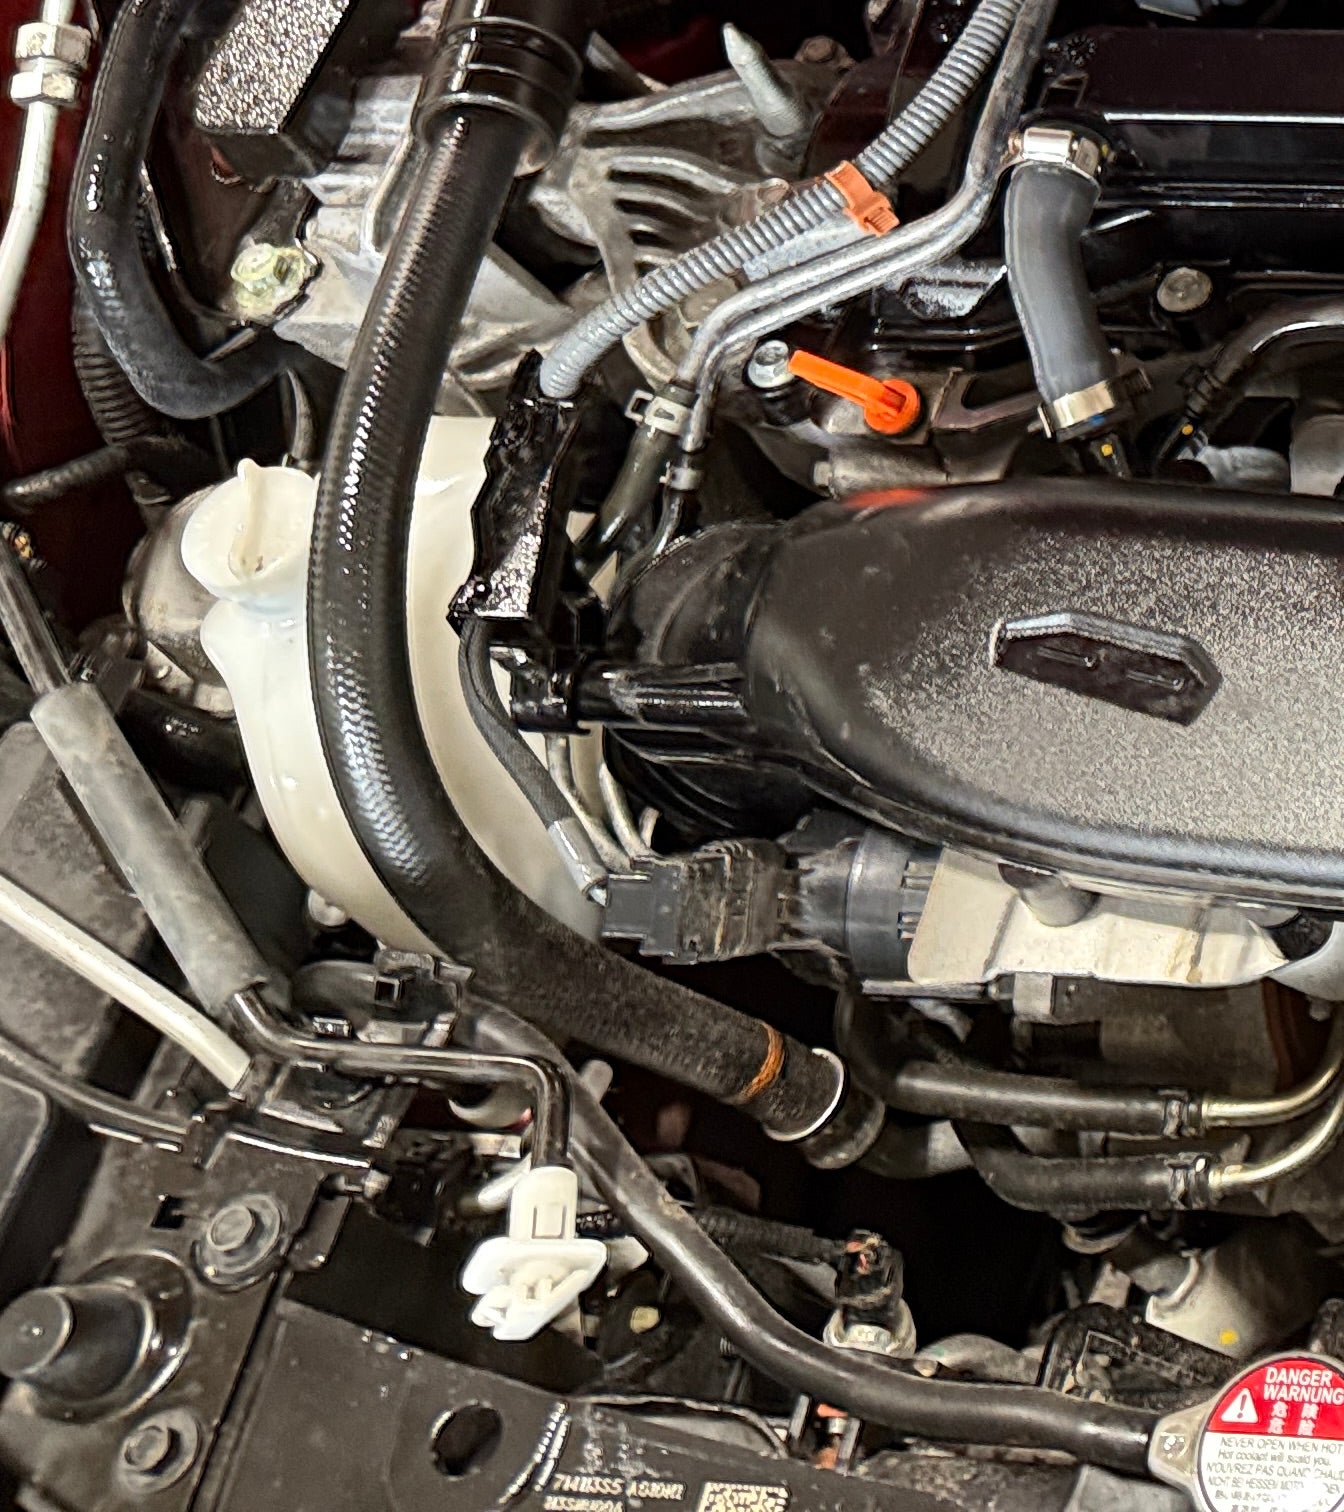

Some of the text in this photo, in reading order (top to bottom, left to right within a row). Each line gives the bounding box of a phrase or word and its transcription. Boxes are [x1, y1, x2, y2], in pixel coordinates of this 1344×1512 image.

[1265, 1366, 1334, 1388] DANGER
[1219, 1437, 1254, 1449] NEVER
[1257, 1439, 1285, 1451] OPEN
[1288, 1441, 1319, 1453] WHEN
[1254, 1465, 1274, 1477] PAS
